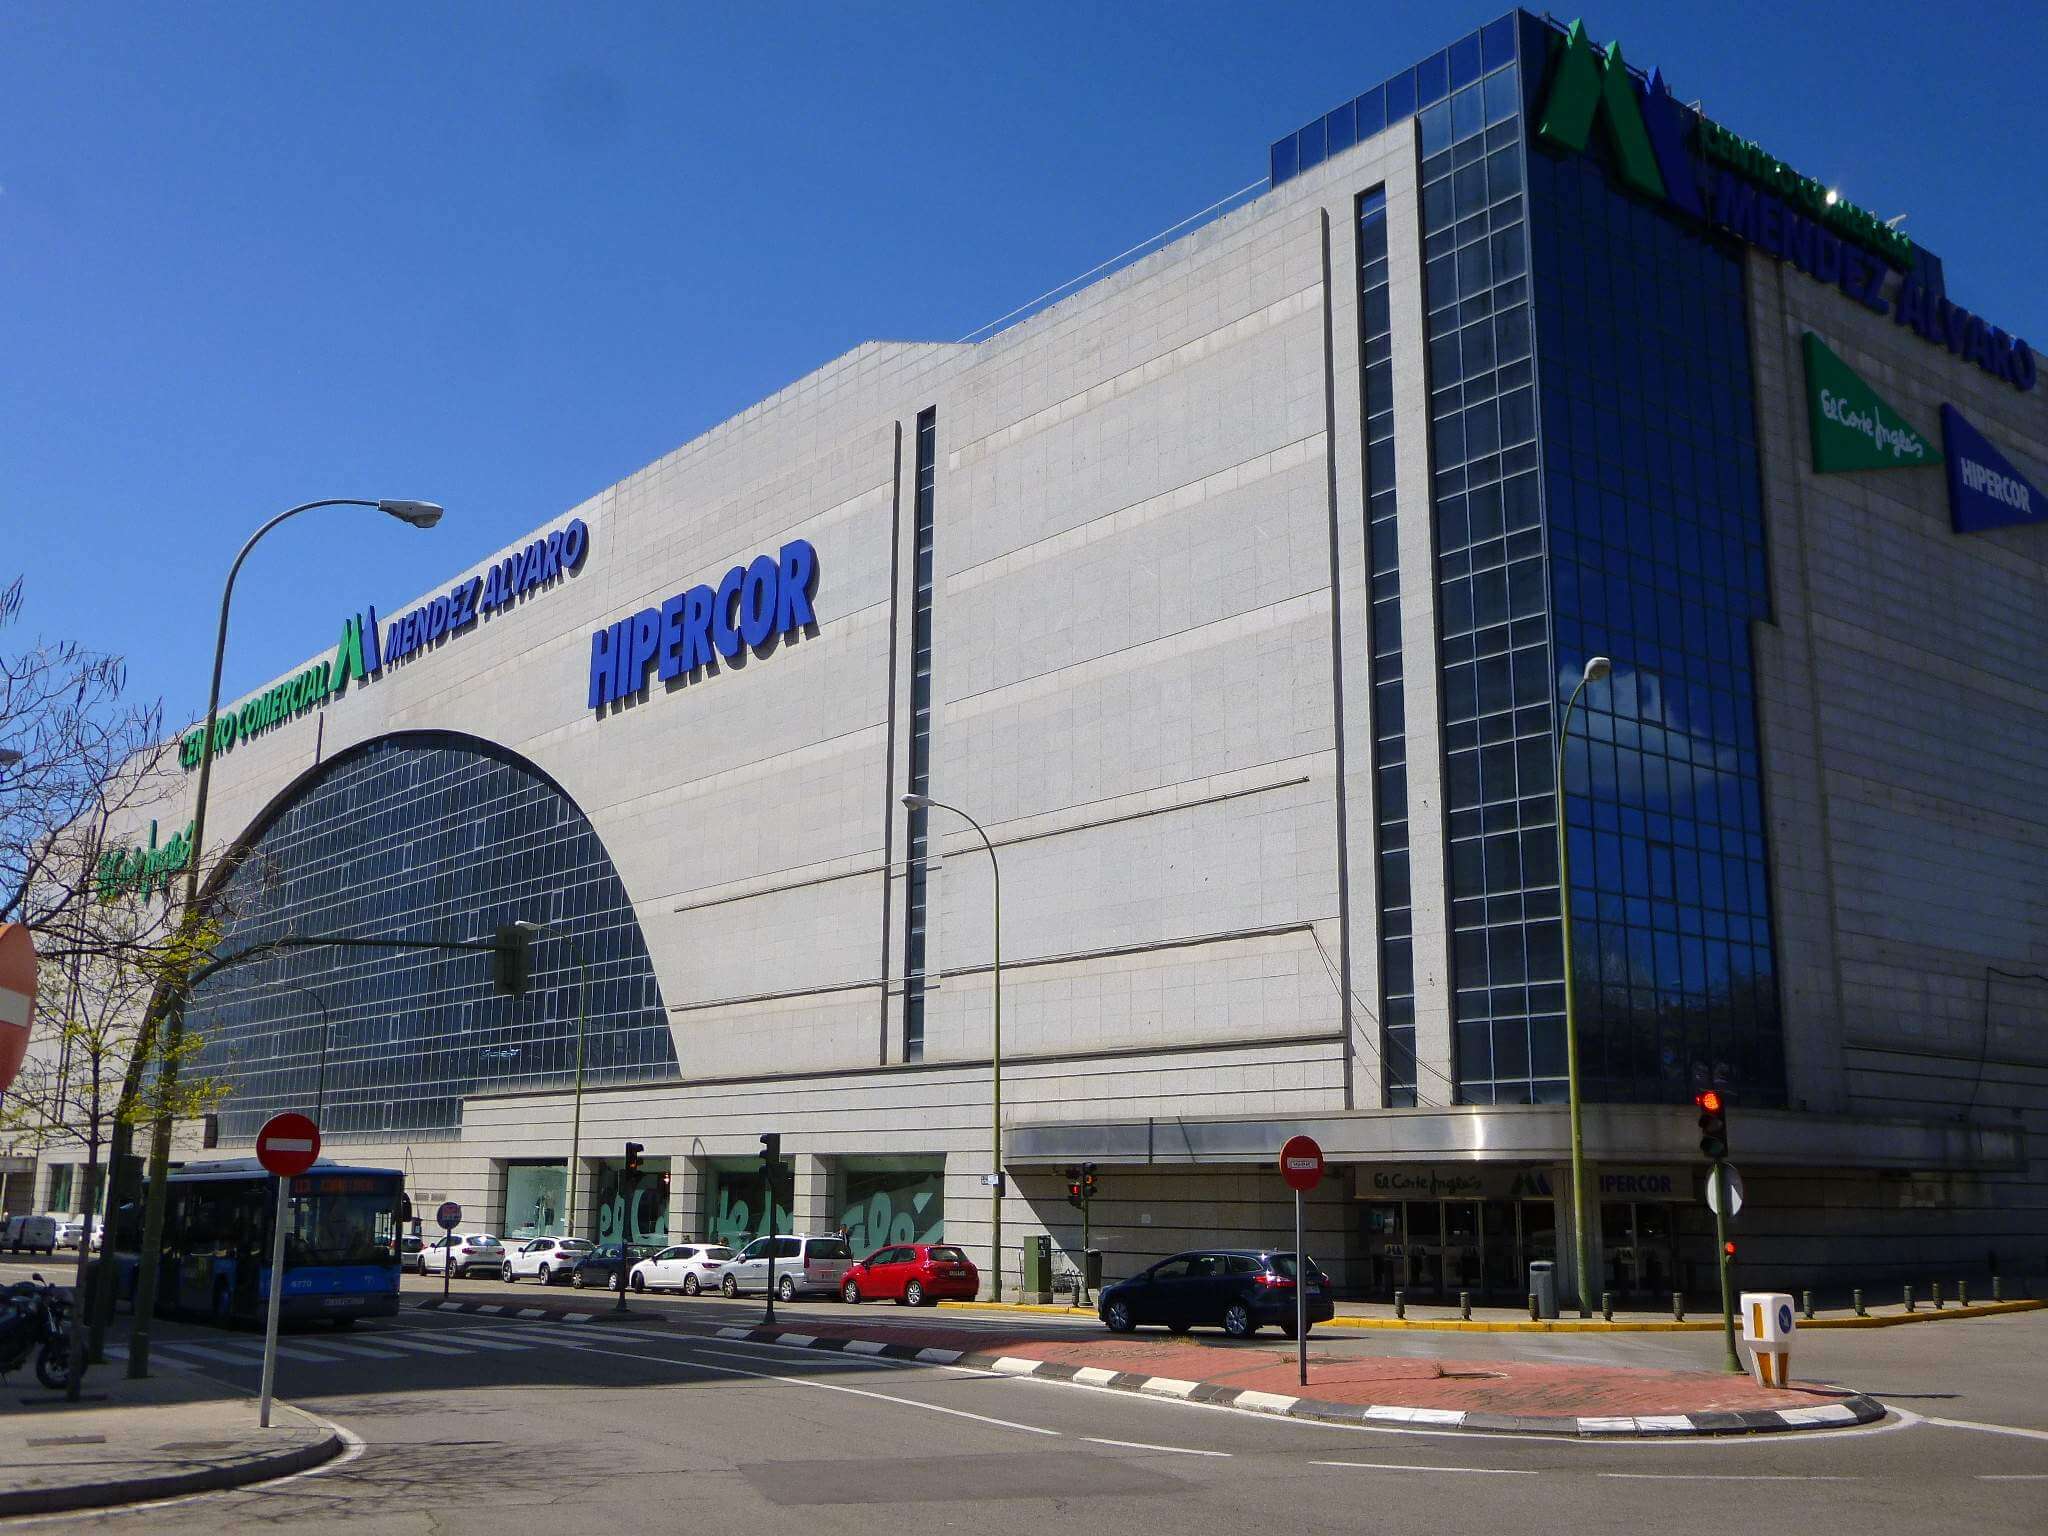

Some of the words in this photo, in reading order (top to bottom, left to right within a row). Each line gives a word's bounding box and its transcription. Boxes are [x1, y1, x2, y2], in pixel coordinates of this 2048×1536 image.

[1709, 163, 1889, 315] MENDEZ
[1895, 270, 2036, 391] ALVARO
[1960, 456, 2033, 514] HIPERCOR
[179, 712, 237, 768] CENRO
[237, 661, 330, 739] COMERCIAL
[384, 575, 484, 665] MENDEZ
[479, 518, 590, 614] ALVARO
[588, 539, 817, 709] HIPERCOR
[1600, 1175, 1672, 1193] IPERCOR
